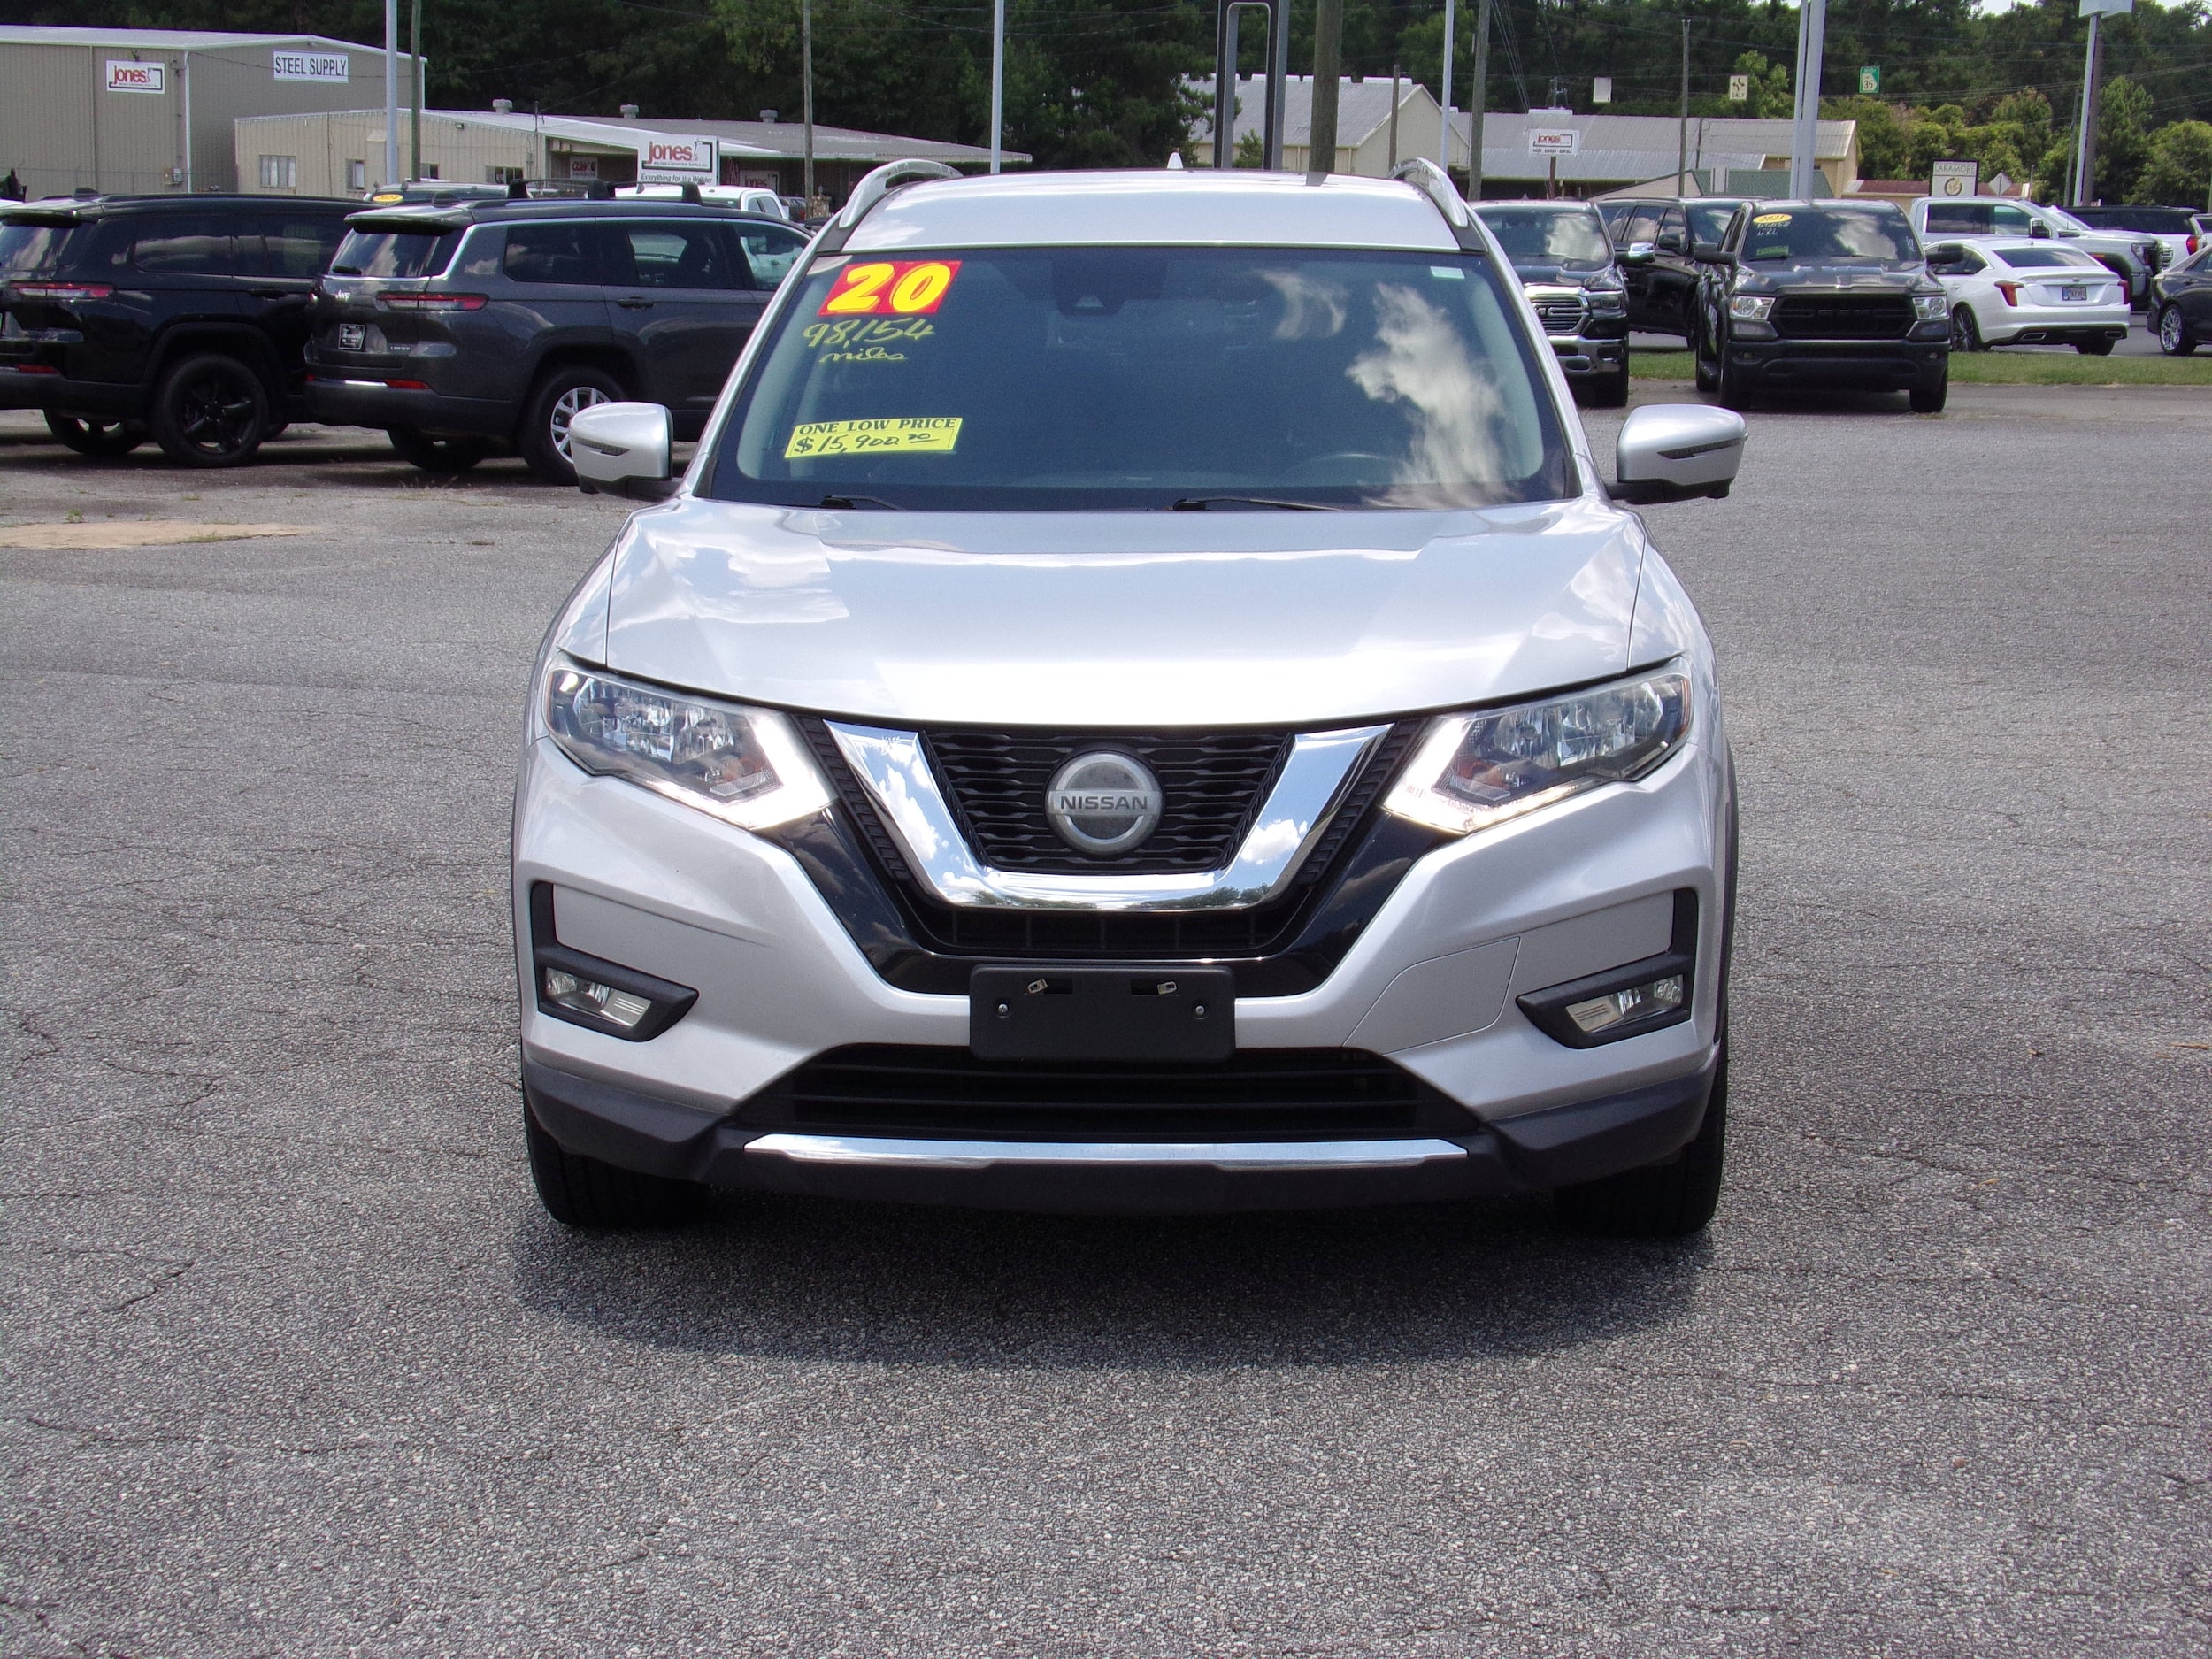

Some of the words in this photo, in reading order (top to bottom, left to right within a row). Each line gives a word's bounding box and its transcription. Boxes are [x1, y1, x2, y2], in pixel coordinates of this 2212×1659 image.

[275, 56, 307, 74] STEEL
[309, 58, 347, 76] SUPPLY
[1863, 80, 1874, 89] 35
[1934, 165, 1976, 173] LARAMORE
[641, 173, 672, 182] Everything
[826, 263, 951, 313] 20
[803, 317, 936, 348] 98,154
[798, 422, 840, 435] ONE
[847, 419, 891, 432] LOW
[898, 418, 956, 430] PRICE
[1060, 795, 1148, 810] NISSAN
